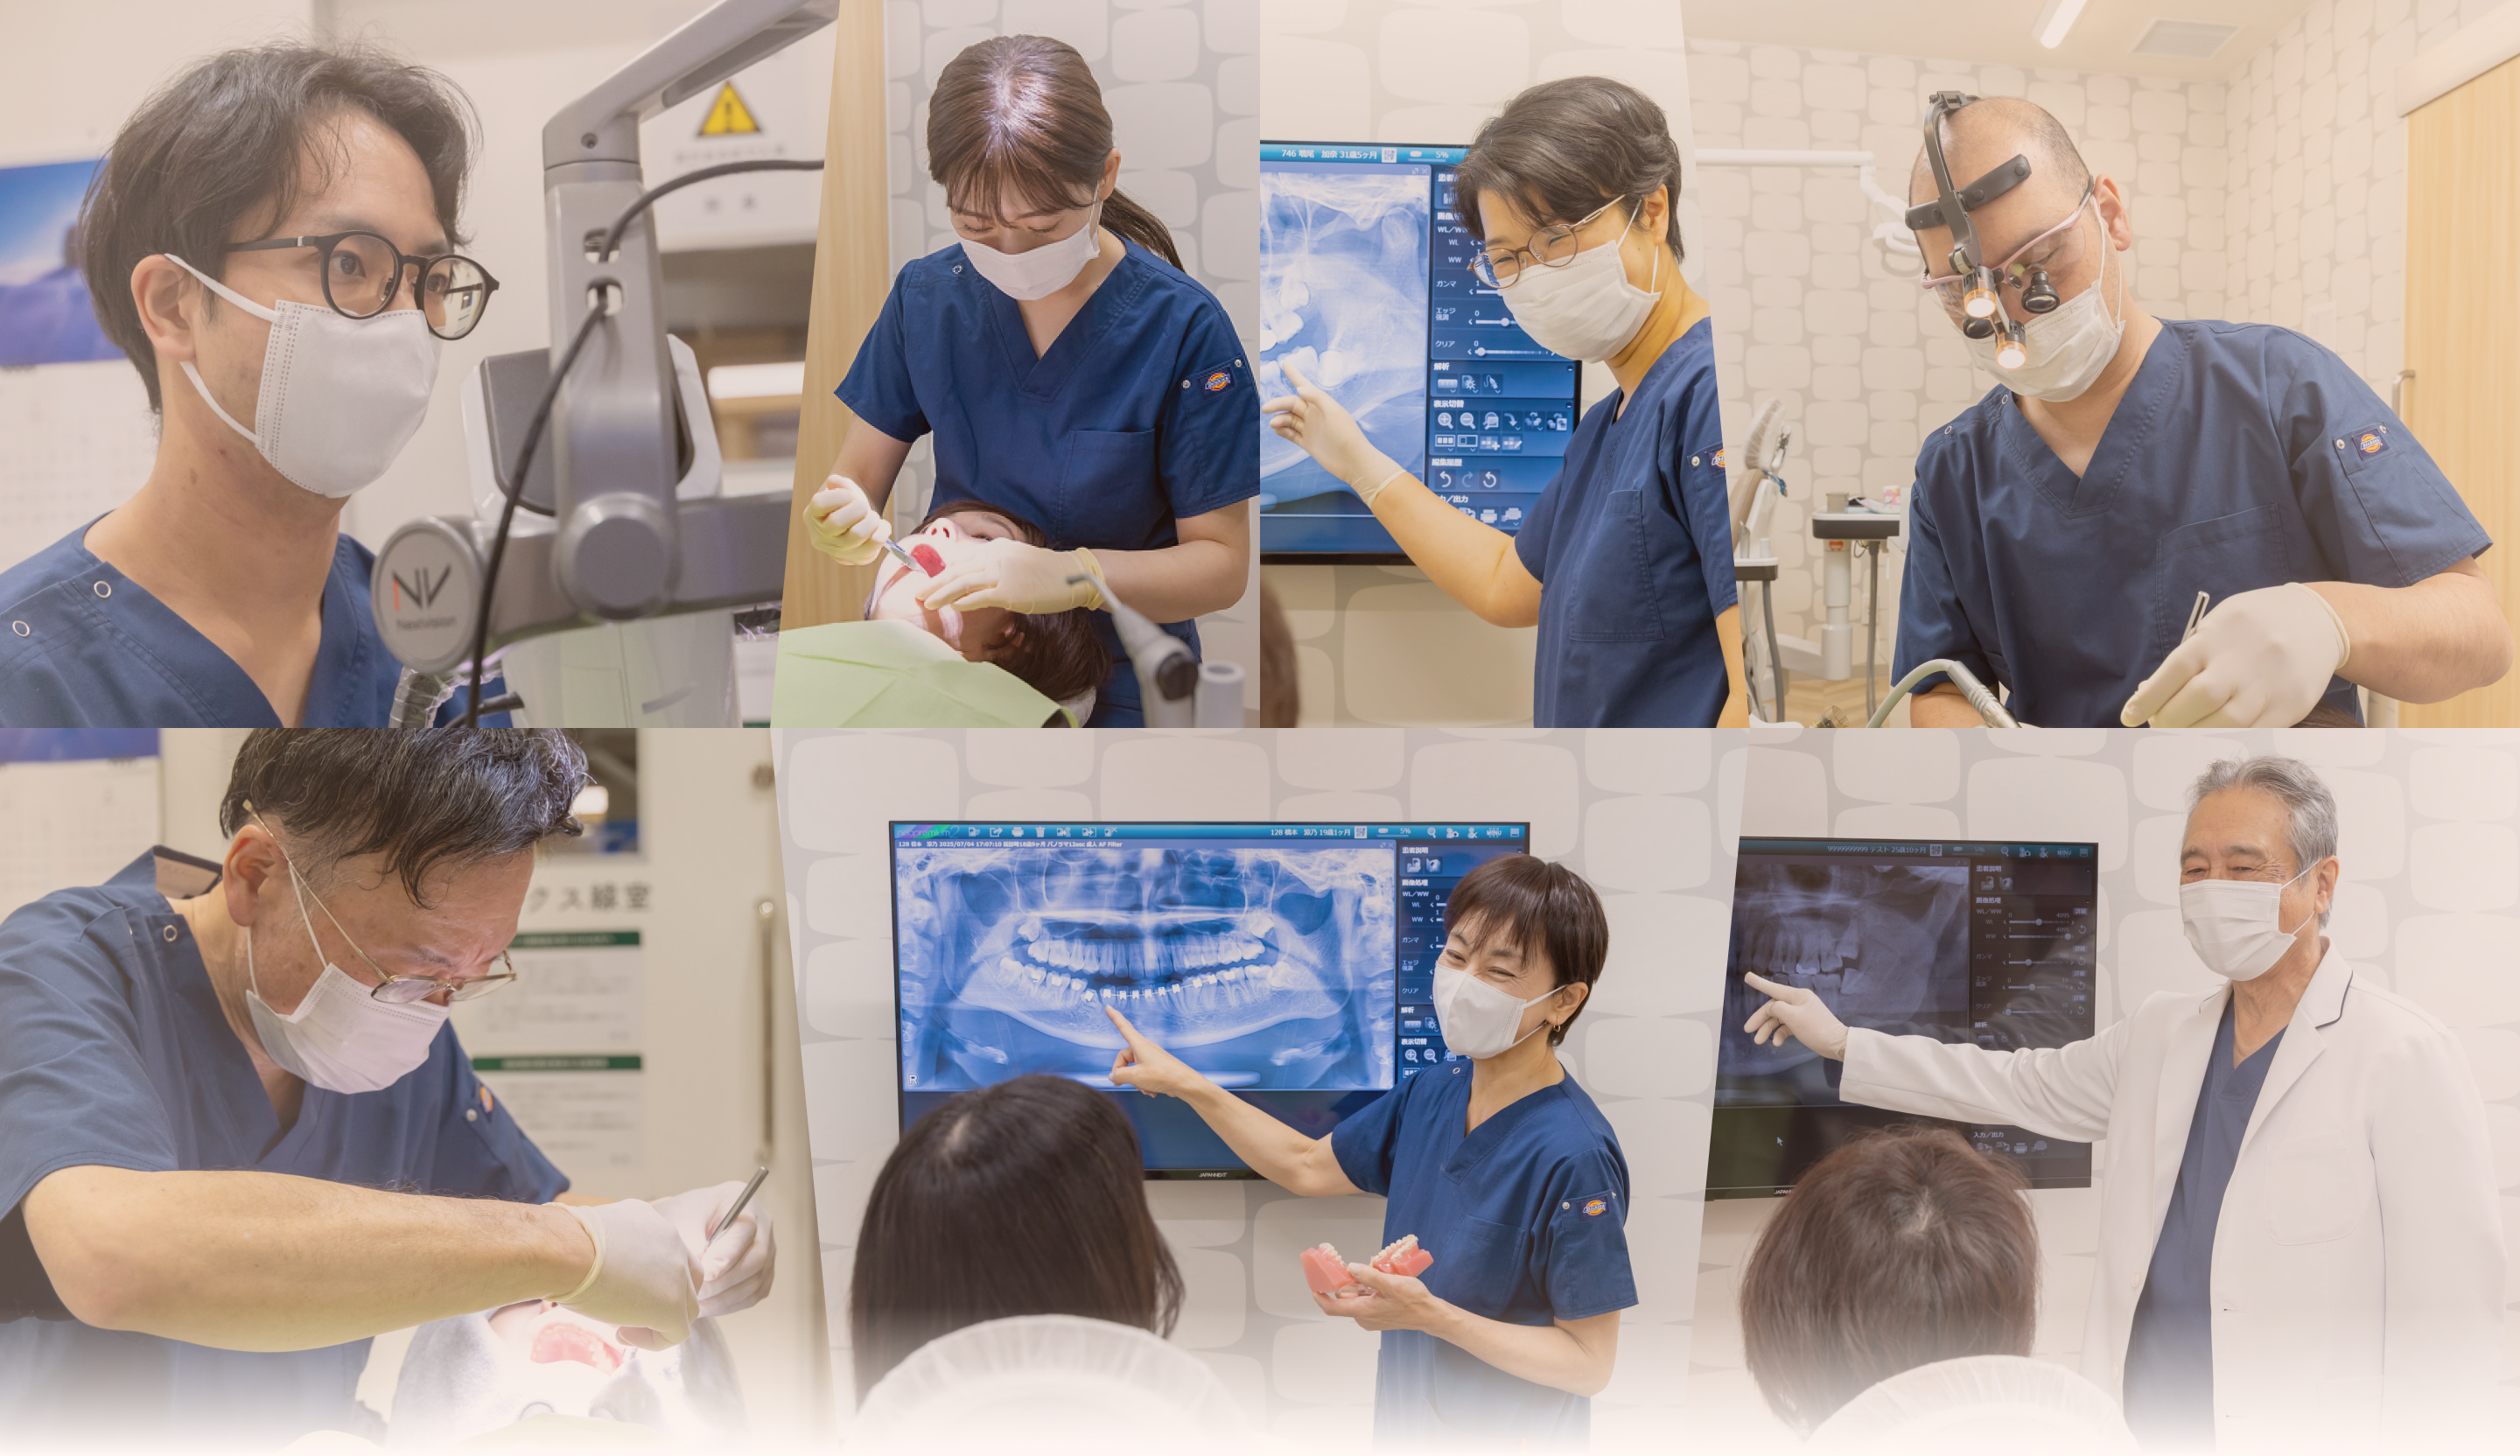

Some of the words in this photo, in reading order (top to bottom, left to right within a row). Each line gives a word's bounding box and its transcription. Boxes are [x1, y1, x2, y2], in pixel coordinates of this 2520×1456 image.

[1281, 149, 1297, 158] 746
[1321, 150, 1338, 158] 加奈
[1433, 362, 1450, 371] 解析
[1433, 400, 1465, 409] 表示切替
[908, 1074, 919, 1086] R
